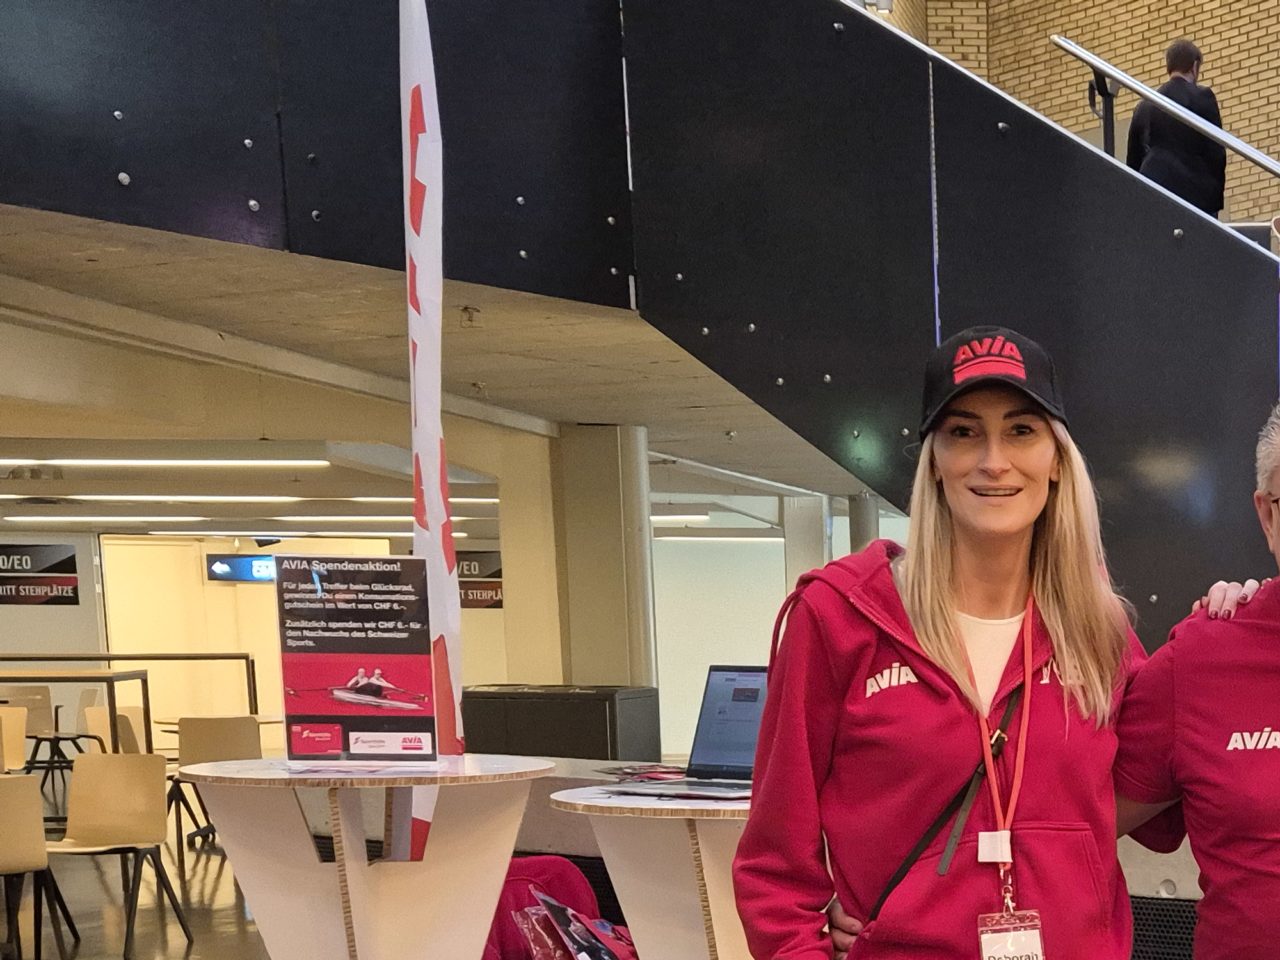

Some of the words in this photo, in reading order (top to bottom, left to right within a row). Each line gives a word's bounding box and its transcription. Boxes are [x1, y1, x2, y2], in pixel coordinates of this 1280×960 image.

[282, 560, 310, 570] AVIA
[312, 560, 402, 572] Spendenaktion!
[283, 582, 296, 590] Für
[19, 584, 74, 597] STEHPLÄTZE
[374, 602, 392, 610] CHF
[378, 621, 396, 629] CHF
